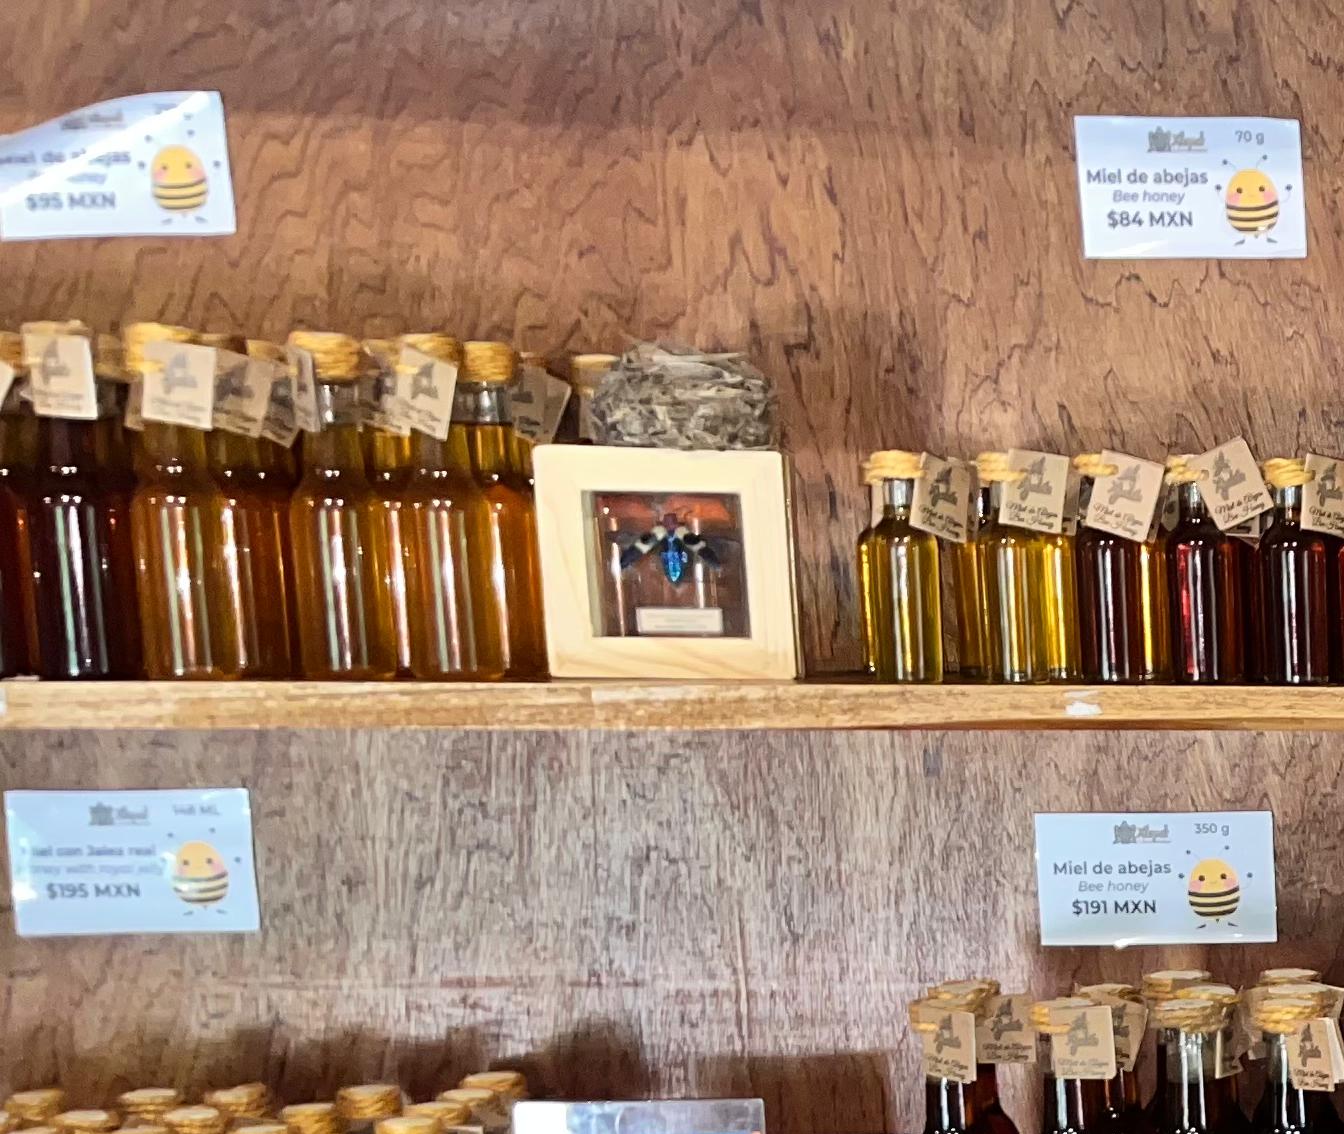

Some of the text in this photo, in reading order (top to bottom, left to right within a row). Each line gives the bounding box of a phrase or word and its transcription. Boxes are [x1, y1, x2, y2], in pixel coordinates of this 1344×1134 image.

[1235, 130, 1265, 146] 70 g
[1087, 169, 1209, 187] Miel de abejas
[25, 191, 116, 212] $95 MXN
[1113, 190, 1185, 205] Bee honey
[1107, 210, 1193, 229] $84 MXN
[1194, 823, 1230, 836] 350 g
[1053, 860, 1172, 877] Miel de abejas
[46, 882, 141, 899] $195 MXN
[1078, 880, 1149, 894] Bee honey
[1072, 899, 1157, 916] $191 MXN
